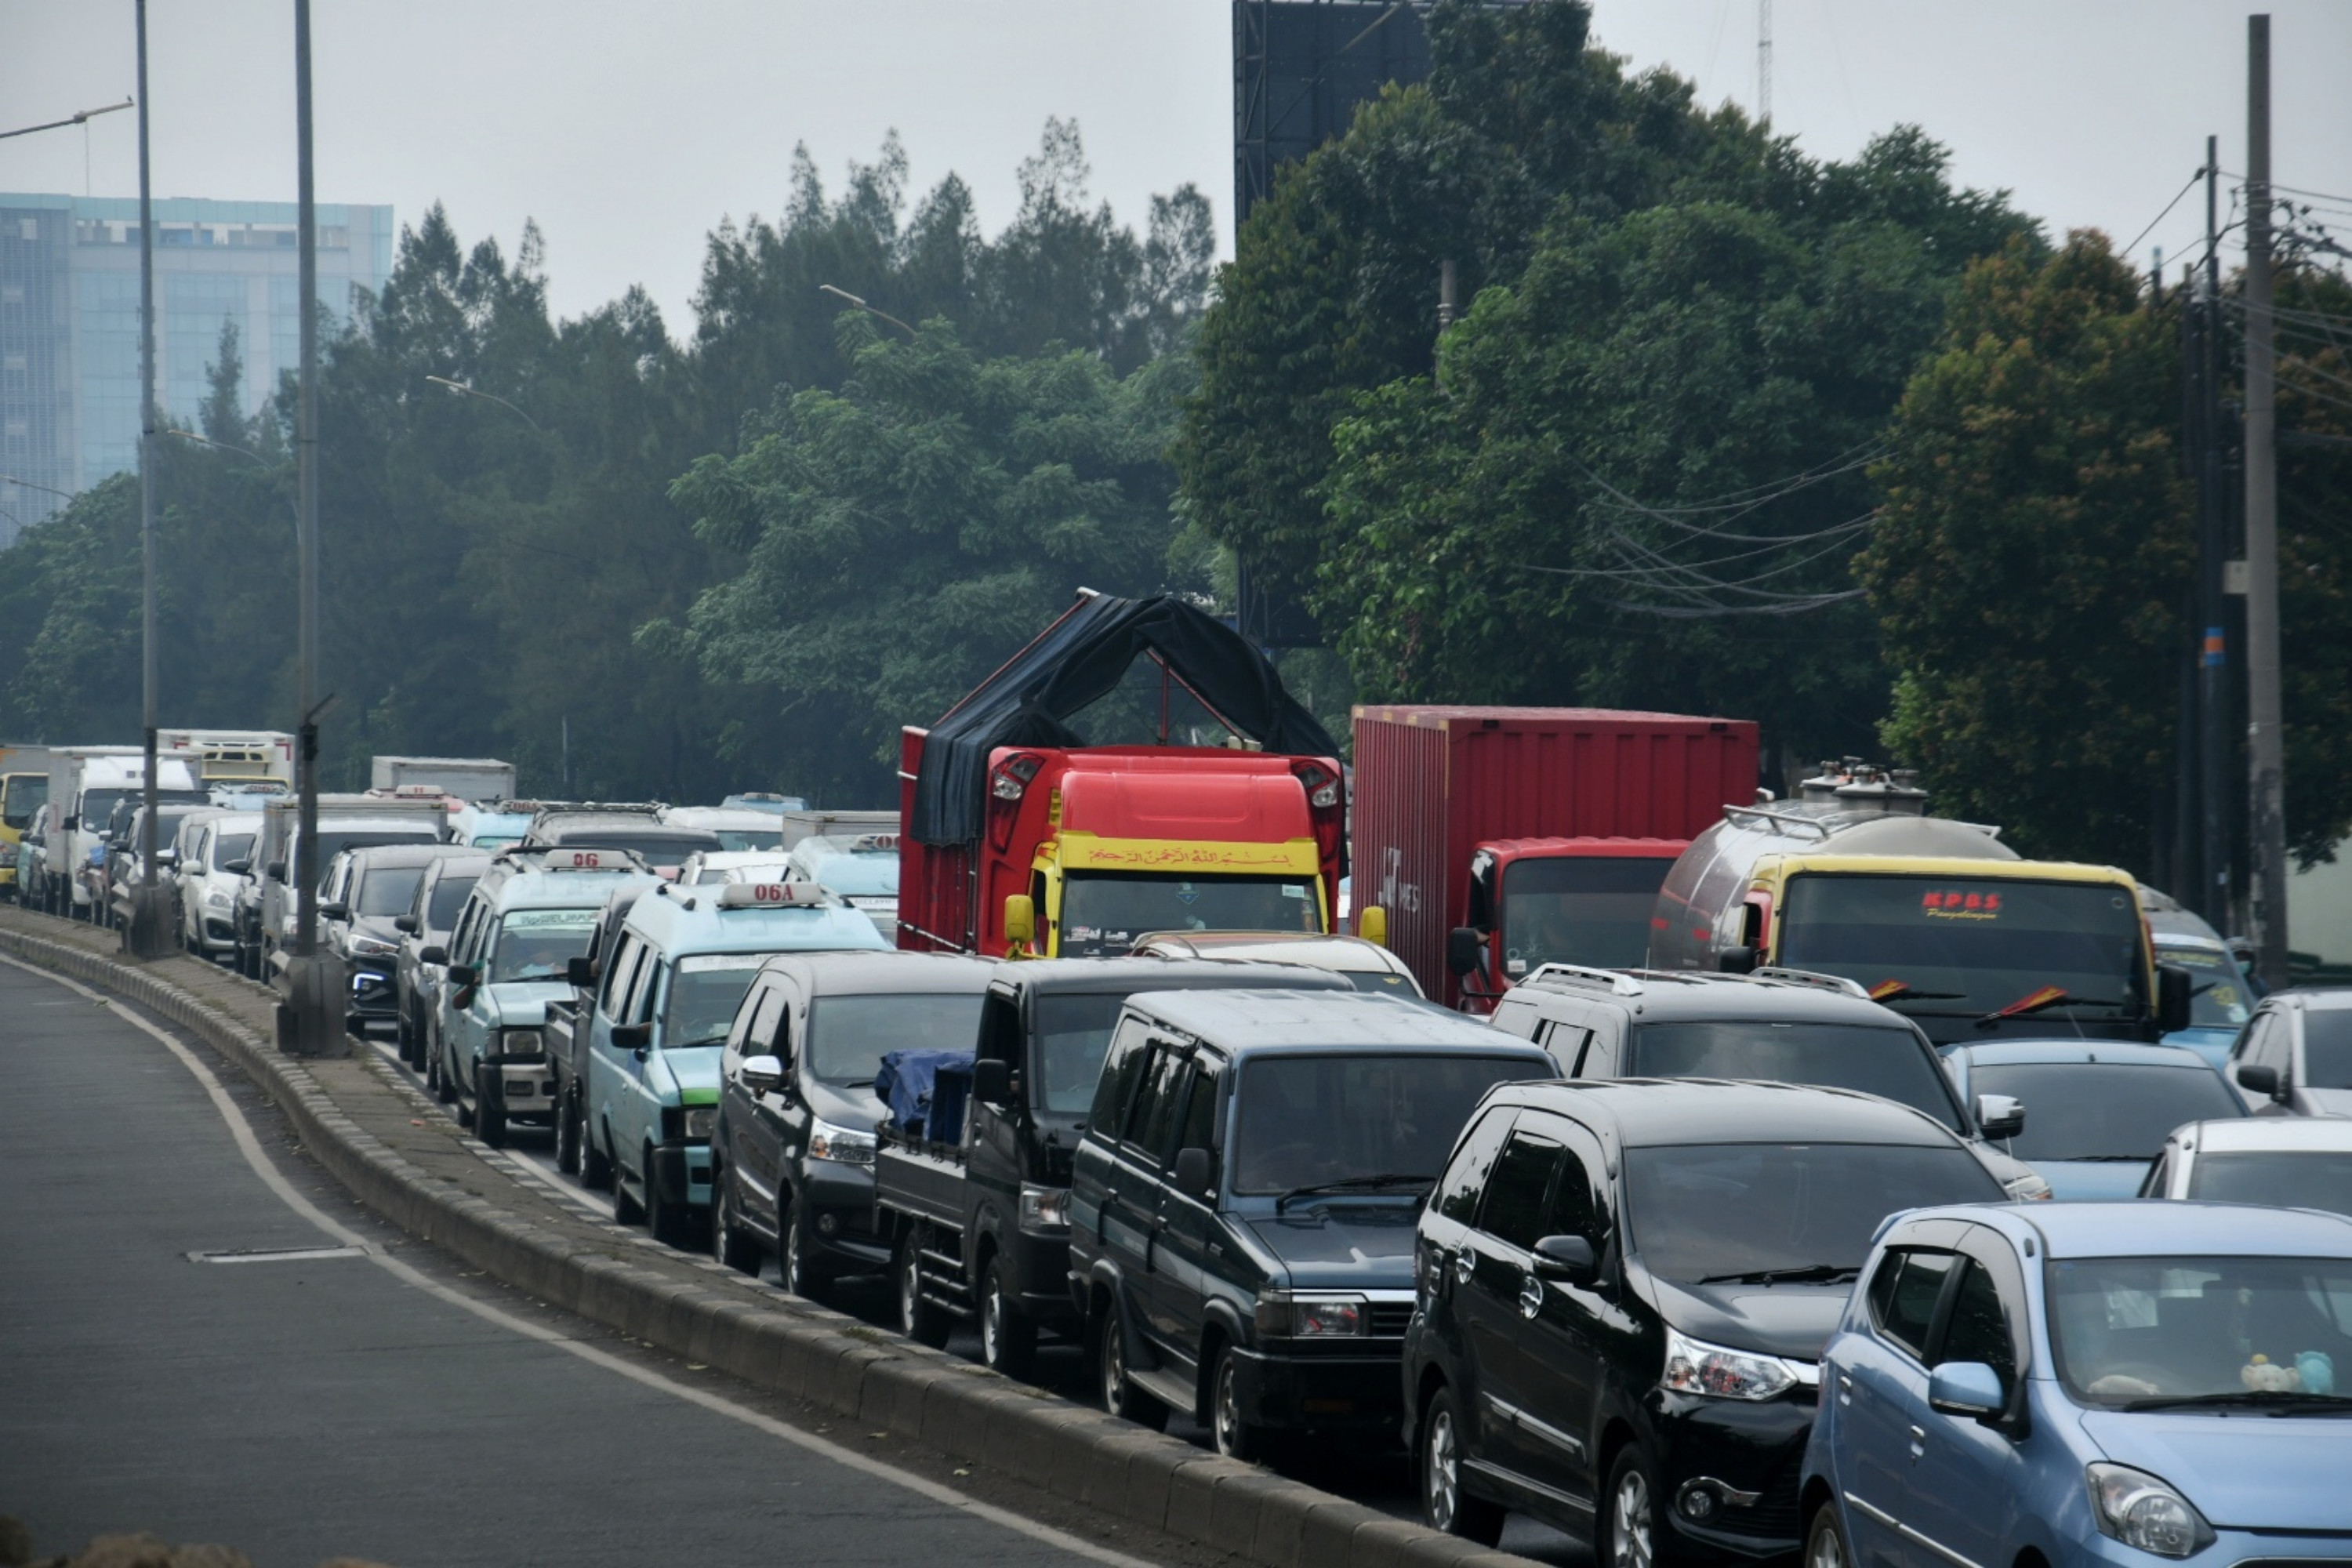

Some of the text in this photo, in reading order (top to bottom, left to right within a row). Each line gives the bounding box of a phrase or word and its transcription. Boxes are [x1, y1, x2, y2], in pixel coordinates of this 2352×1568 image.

[573, 852, 599, 867] 06
[754, 883, 794, 902] 06A
[1922, 891, 2001, 910] KPBS
